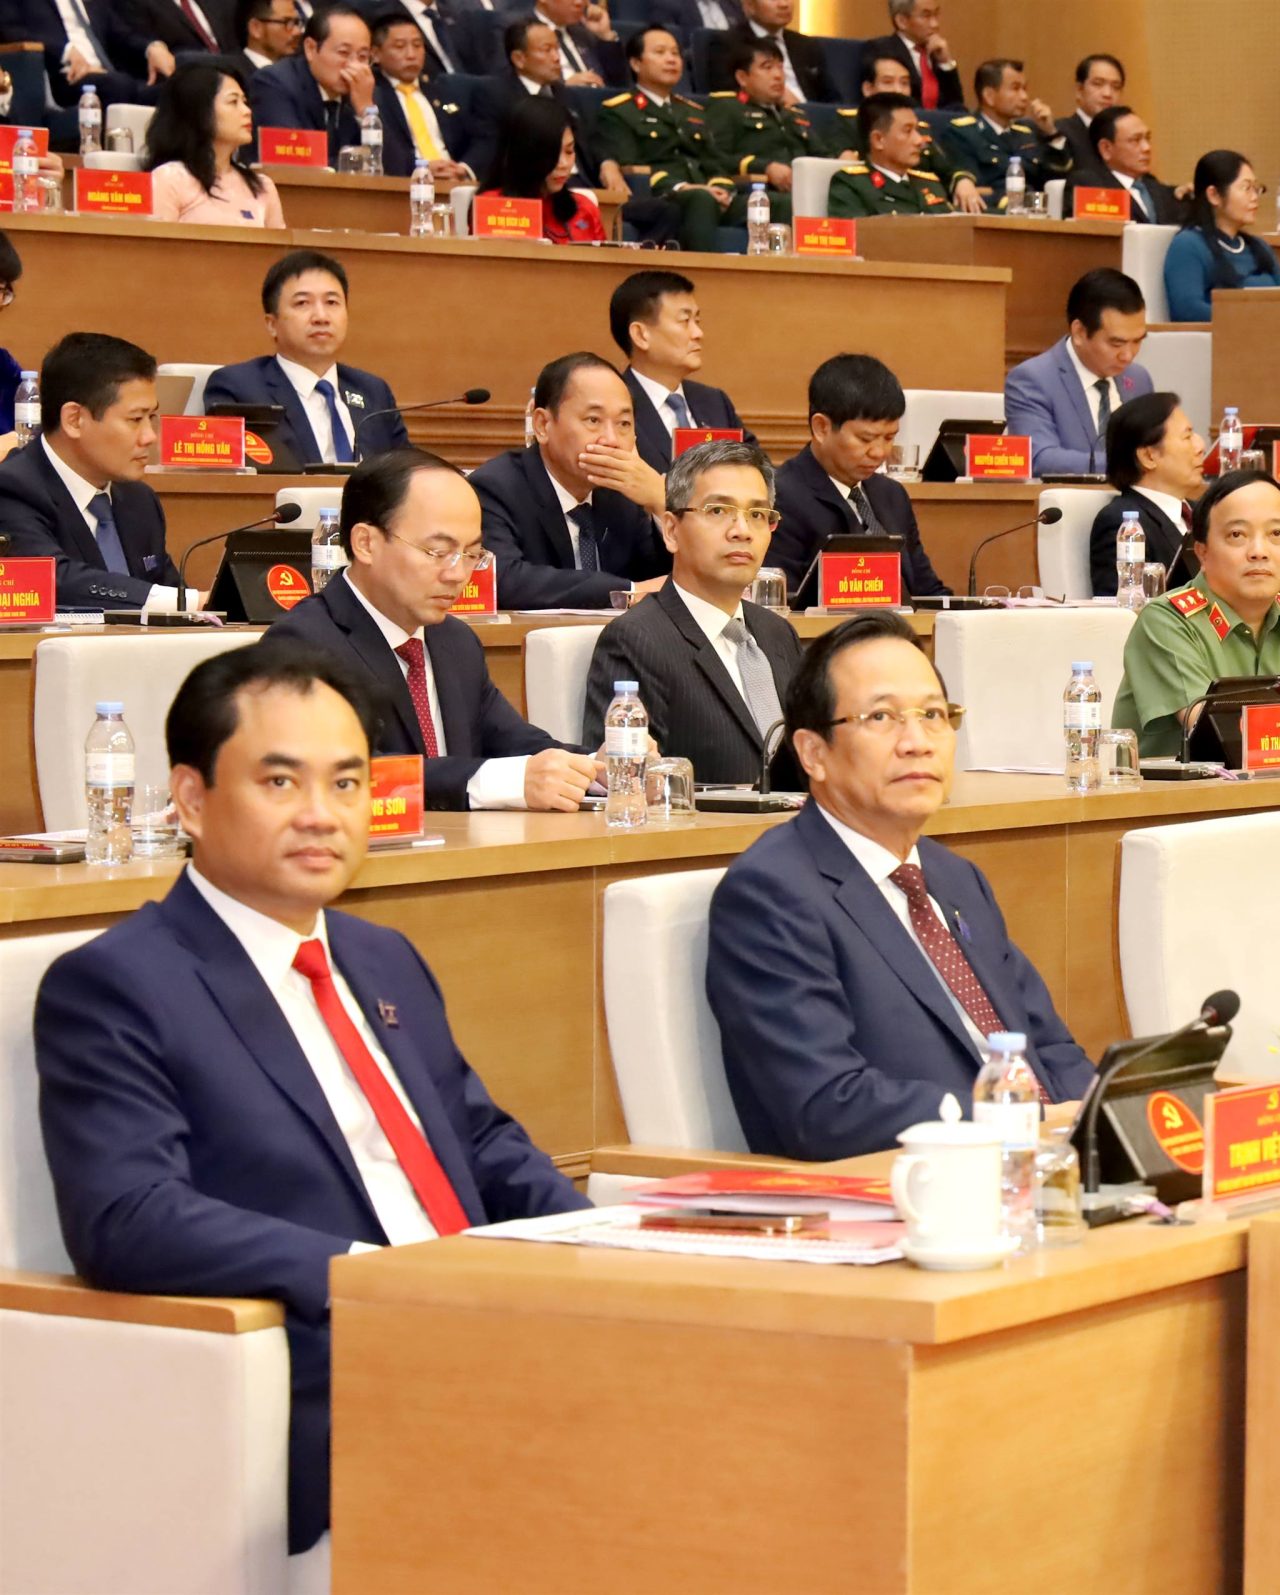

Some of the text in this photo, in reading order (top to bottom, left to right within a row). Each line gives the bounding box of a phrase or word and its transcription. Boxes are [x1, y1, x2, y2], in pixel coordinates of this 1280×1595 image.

[173, 440, 183, 454] LÊ
[183, 442, 195, 456] THỊ
[839, 576, 883, 593] ĐỖ VĂN CHIẾN
[13, 590, 40, 607] NGHĨA
[1260, 734, 1271, 751] VÕ
[385, 796, 407, 816] SƠN
